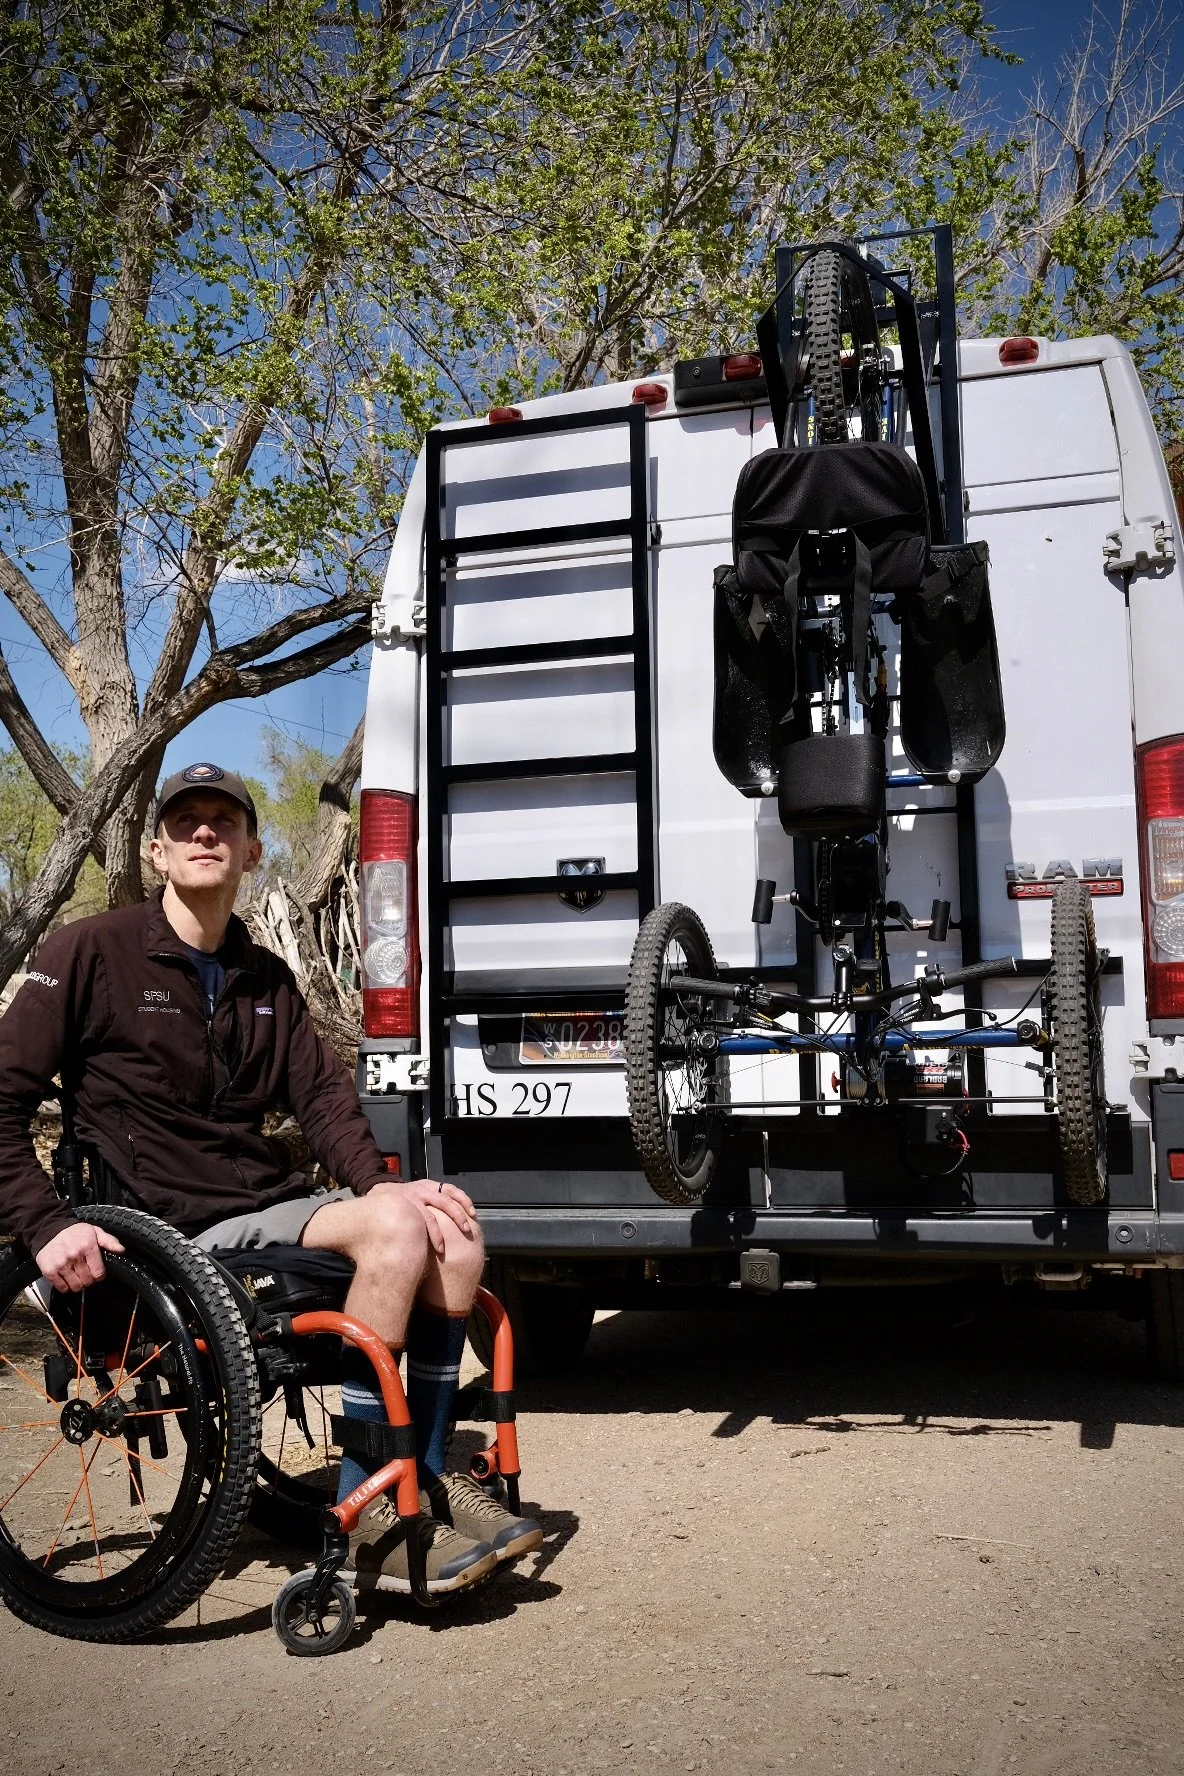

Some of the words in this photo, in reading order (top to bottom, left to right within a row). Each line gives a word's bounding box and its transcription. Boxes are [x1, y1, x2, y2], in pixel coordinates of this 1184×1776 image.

[1005, 858, 1123, 880] RAM
[1013, 883, 1119, 894] PROMTER
[511, 1082, 572, 1115] 297
[253, 1275, 276, 1289] JAVA
